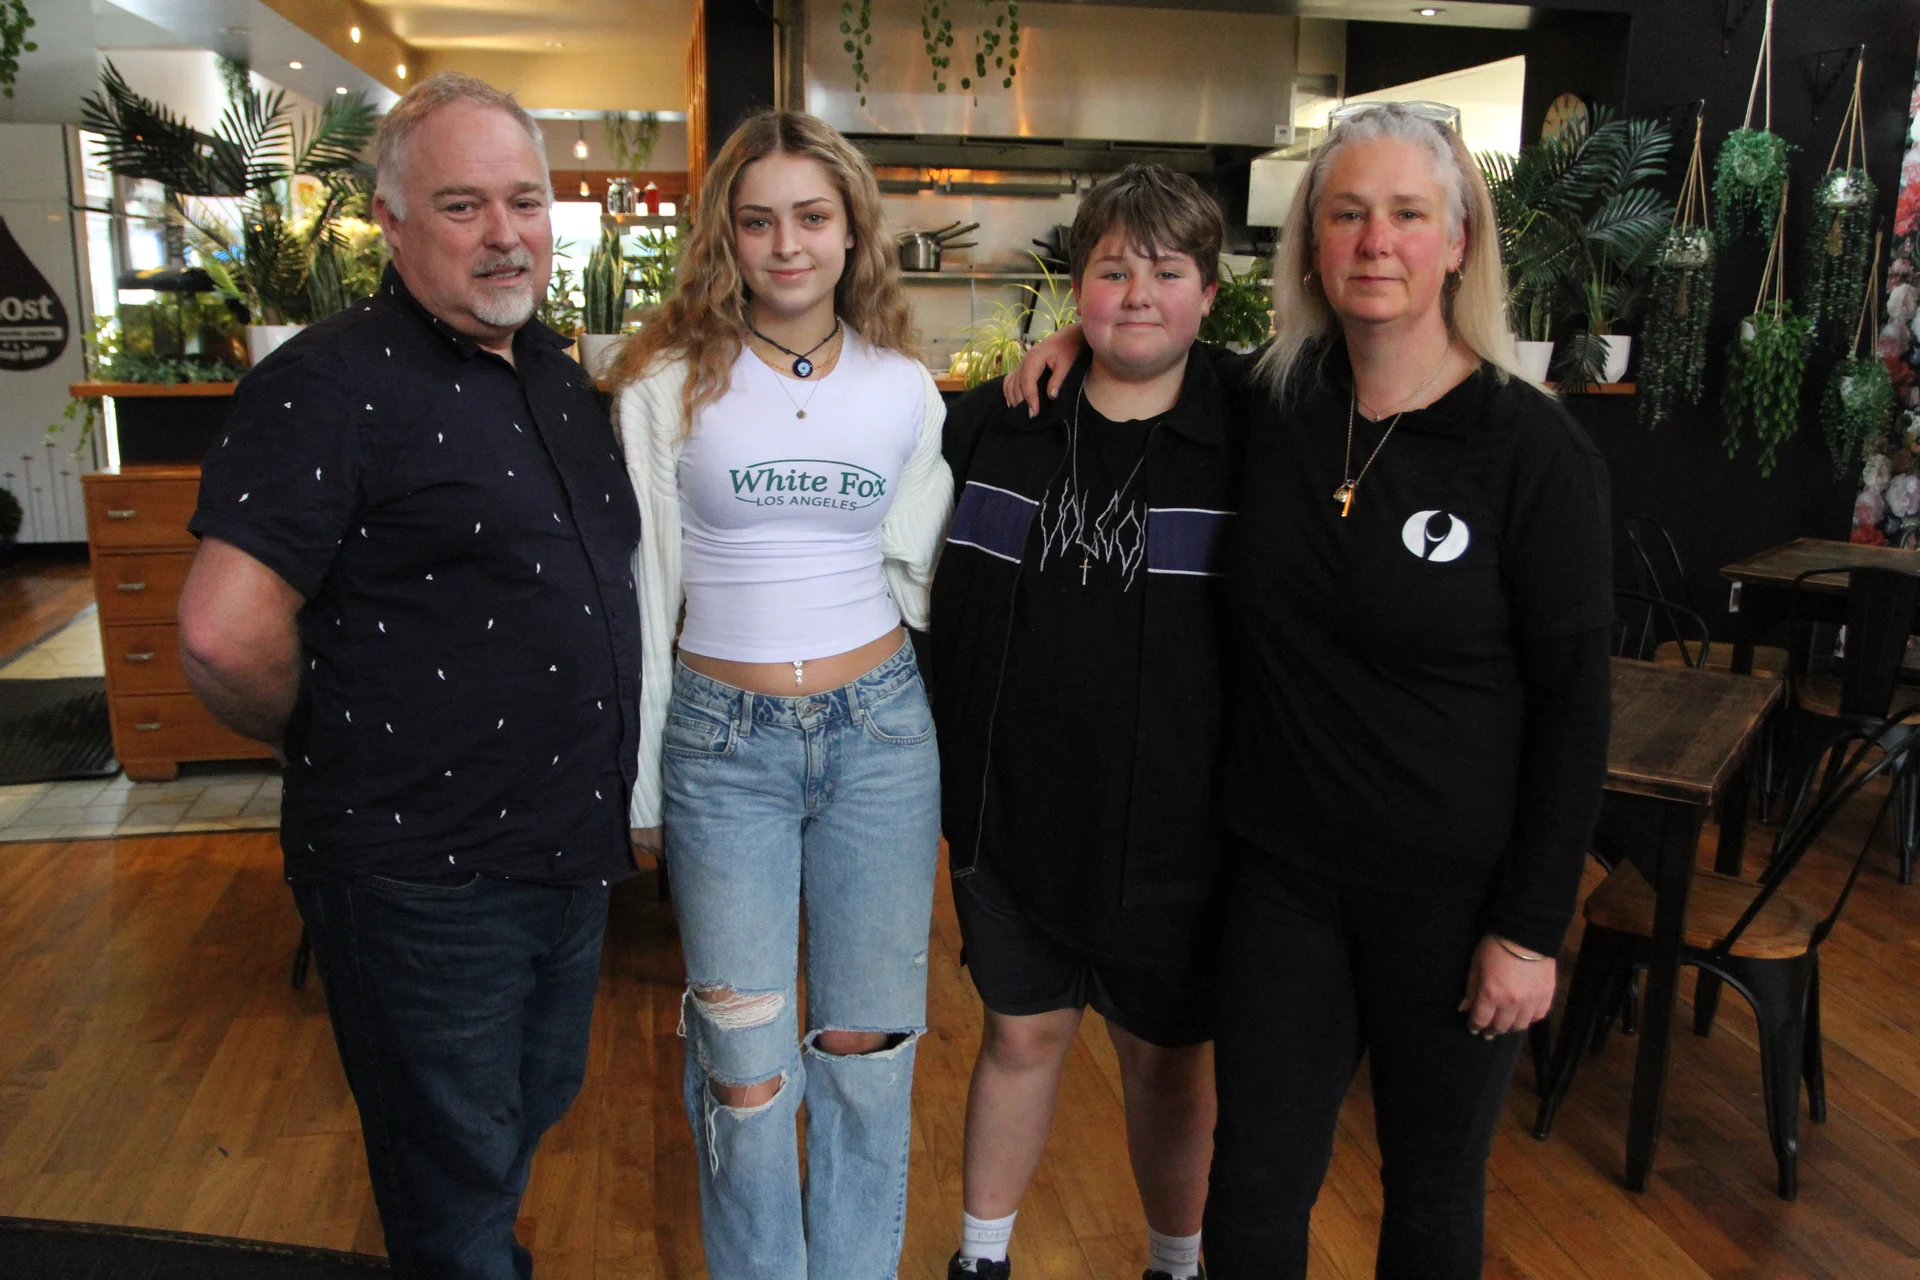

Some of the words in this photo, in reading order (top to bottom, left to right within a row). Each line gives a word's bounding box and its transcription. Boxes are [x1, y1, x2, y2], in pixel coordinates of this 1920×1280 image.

[729, 468, 828, 495] White
[838, 471, 887, 498] Fox
[756, 496, 785, 507] LOS
[789, 498, 857, 511] ANGELES
